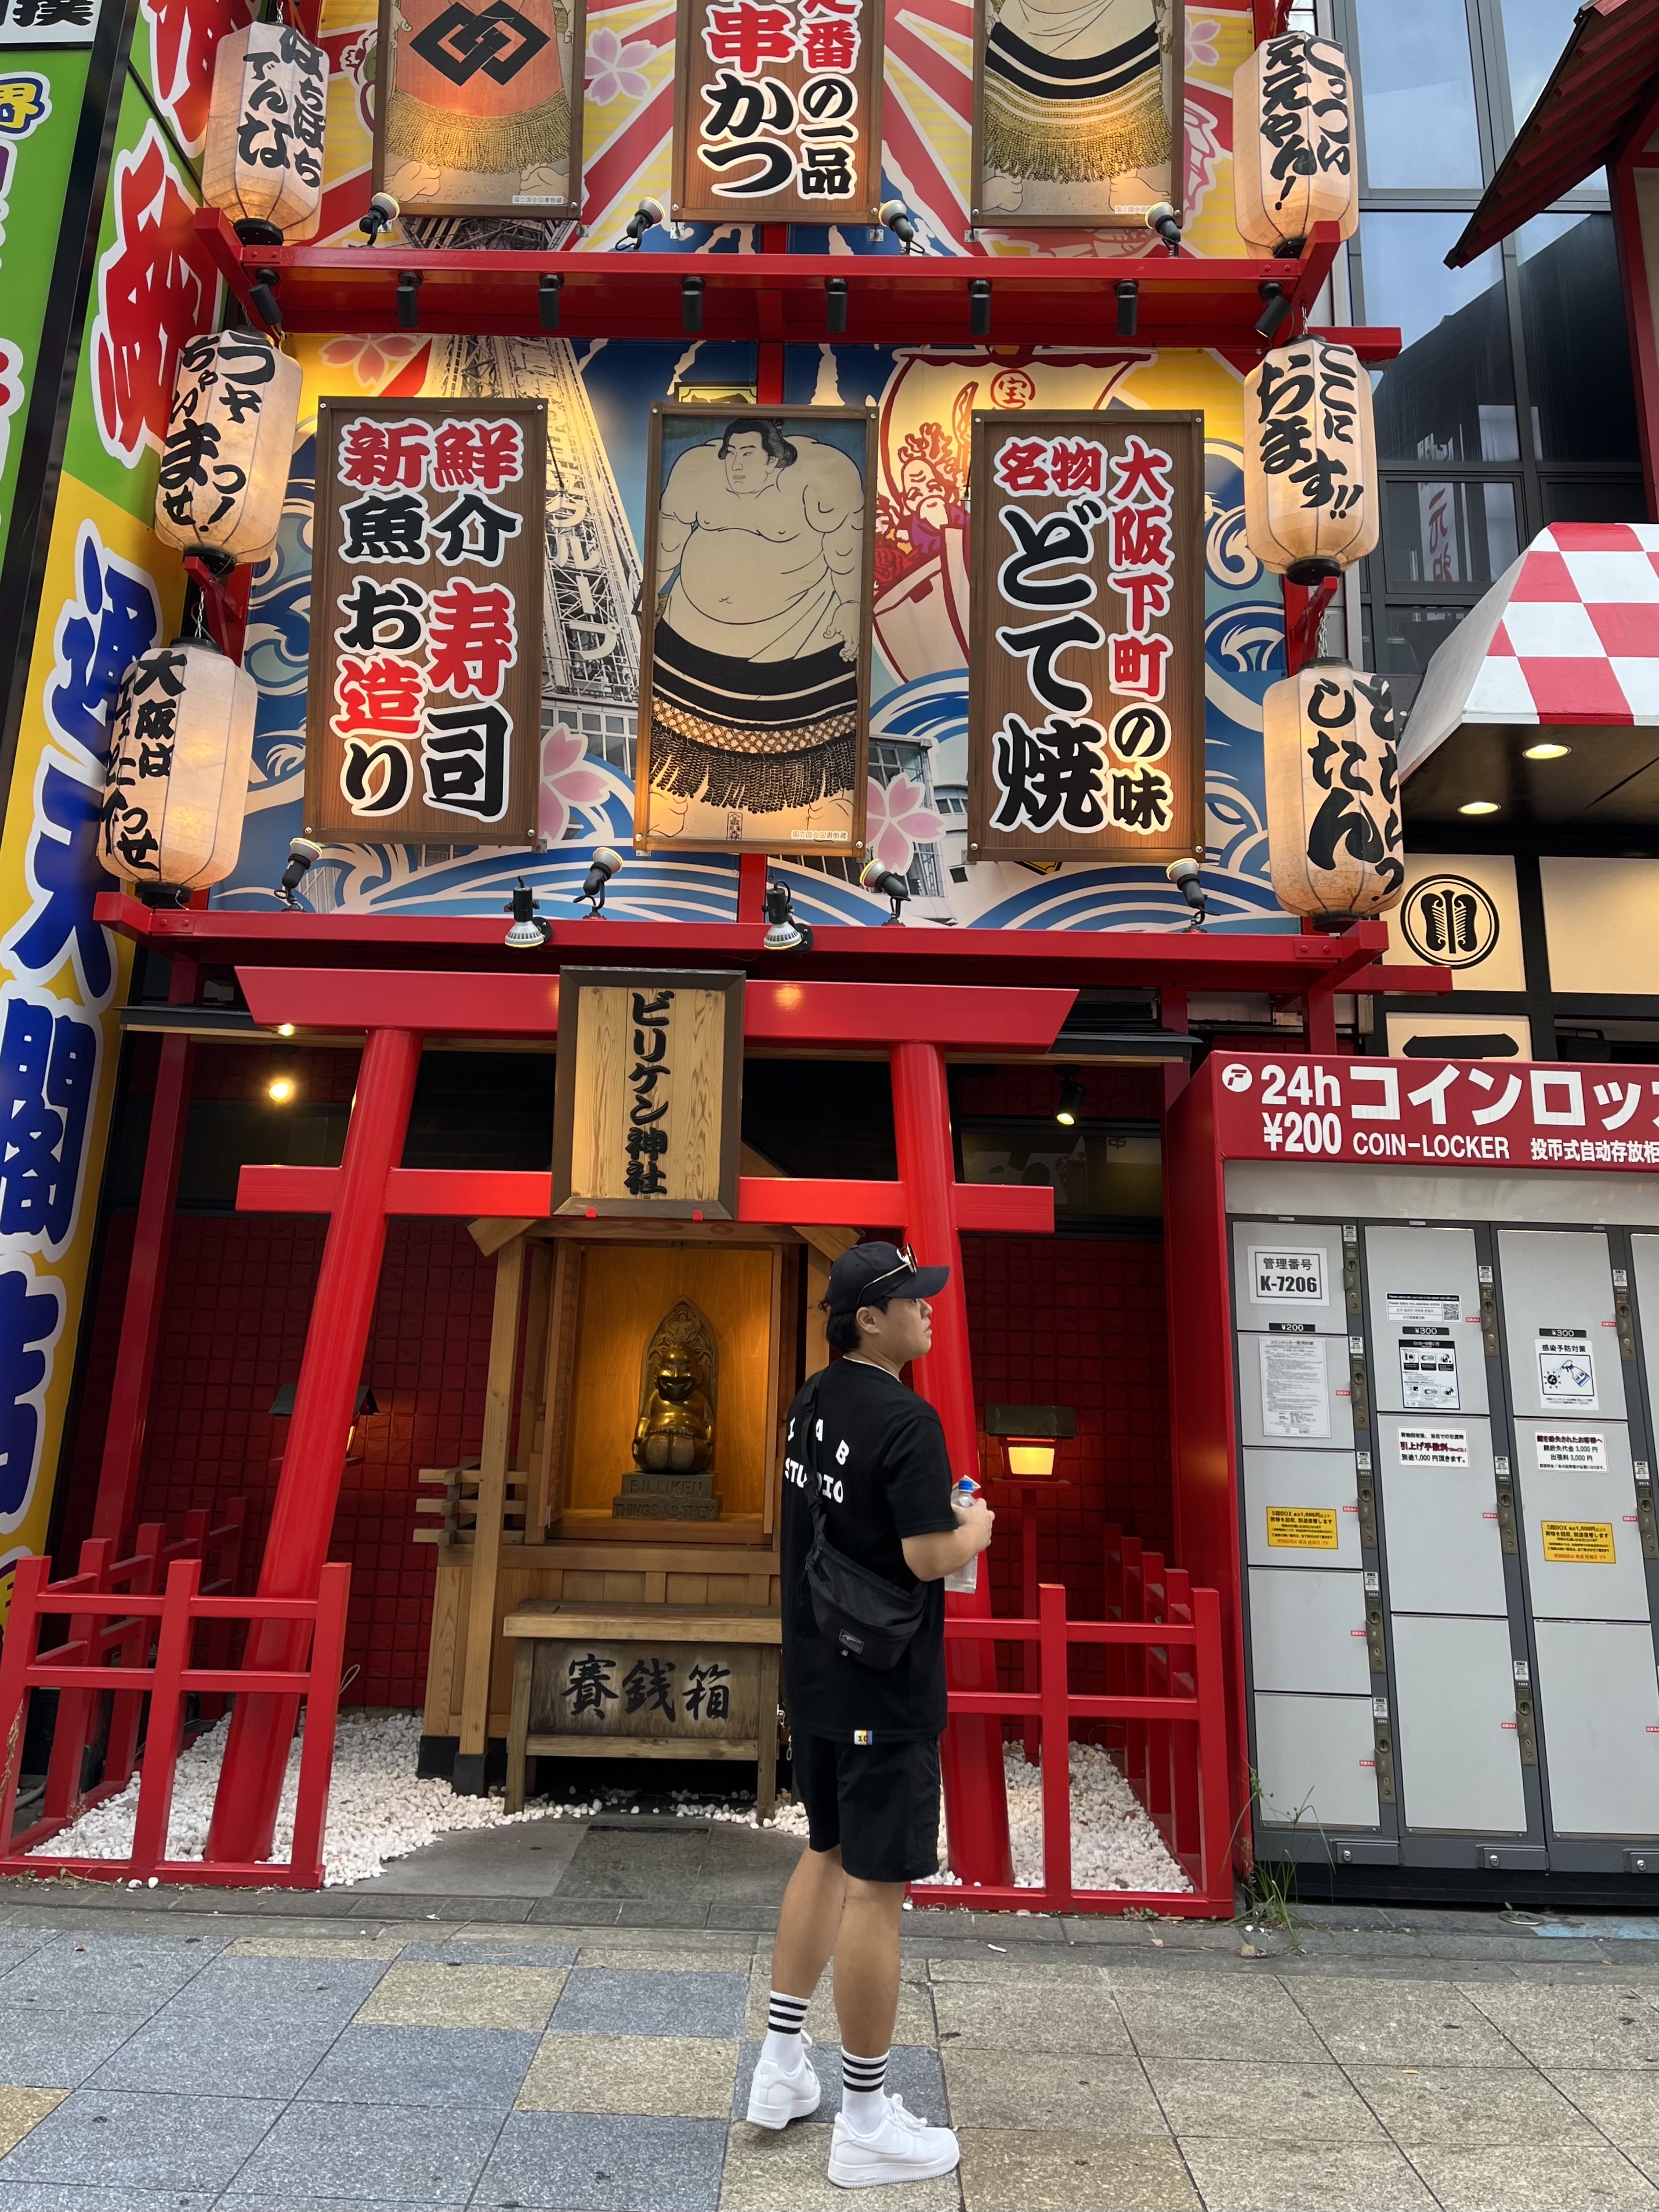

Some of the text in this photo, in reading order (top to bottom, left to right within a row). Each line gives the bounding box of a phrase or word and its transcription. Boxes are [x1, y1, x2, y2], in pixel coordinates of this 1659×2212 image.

[702, 2, 796, 193] 串かつ
[802, 0, 857, 194] 番の一品
[998, 376, 1027, 405] 宝
[1319, 342, 1357, 444] ここに
[343, 422, 521, 489] 新鮮
[999, 441, 1102, 494] 名物
[343, 493, 519, 562] 魚介
[991, 499, 1104, 828] どて焼
[1112, 440, 1169, 830] 大阪下町の味
[133, 650, 187, 779] 大阪は
[337, 580, 423, 812] お造り
[427, 581, 512, 817] 寿司
[624, 991, 675, 1195] ビリケン神社
[1260, 1064, 1341, 1107] 24h
[1262, 1112, 1342, 1154] ¥200
[1353, 1132, 1509, 1159] COIN-LOCKER
[1260, 1276, 1317, 1293] K-7206
[1263, 1257, 1313, 1270] 管理番号
[1542, 1344, 1586, 1353] 感染予防対策
[630, 1479, 702, 1496] BILLIKEN
[560, 1653, 731, 1722] 賽銭箱
